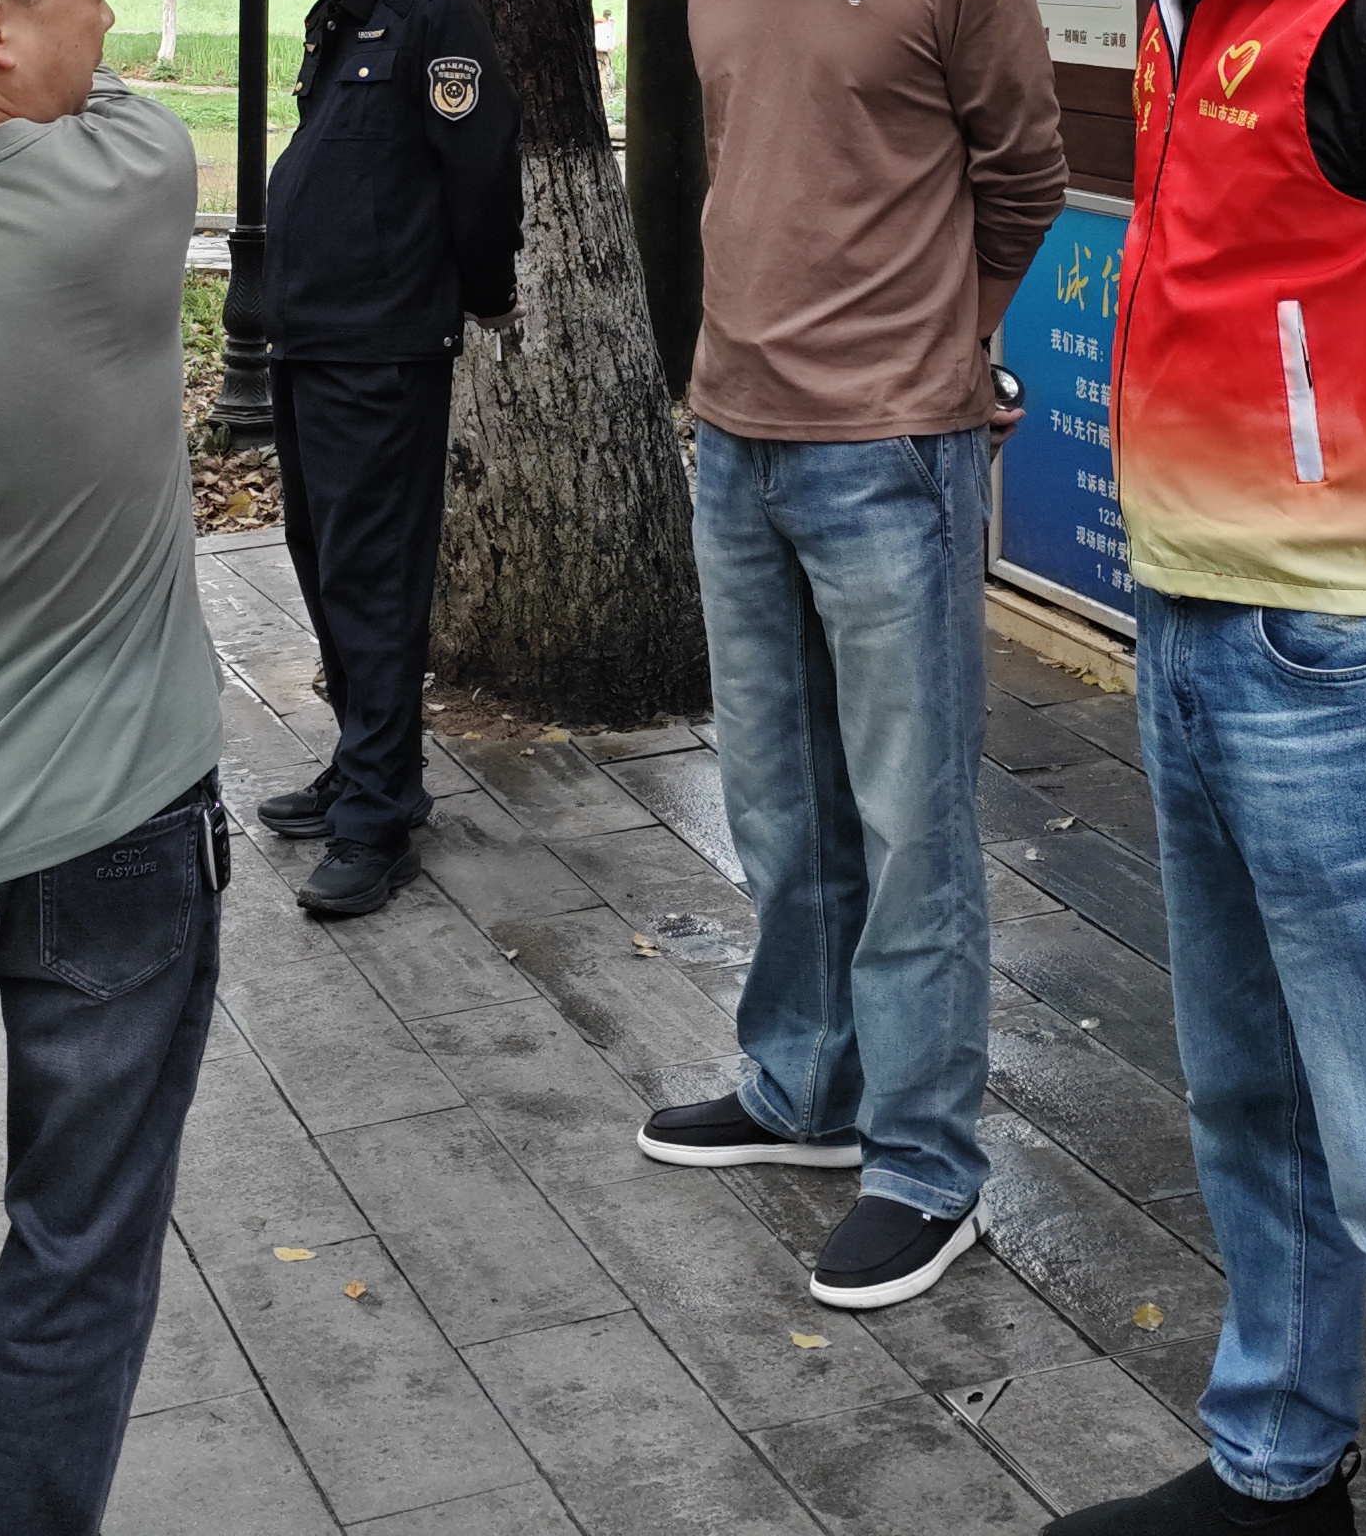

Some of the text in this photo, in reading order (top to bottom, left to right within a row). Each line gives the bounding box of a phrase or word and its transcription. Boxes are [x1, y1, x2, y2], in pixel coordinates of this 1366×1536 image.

[1199, 98, 1259, 130] 韶山市志愿者
[1050, 408, 1110, 450] 予以先行赔
[1077, 468, 1117, 501] 投诉电话
[1075, 525, 1128, 563] 现场赔付受
